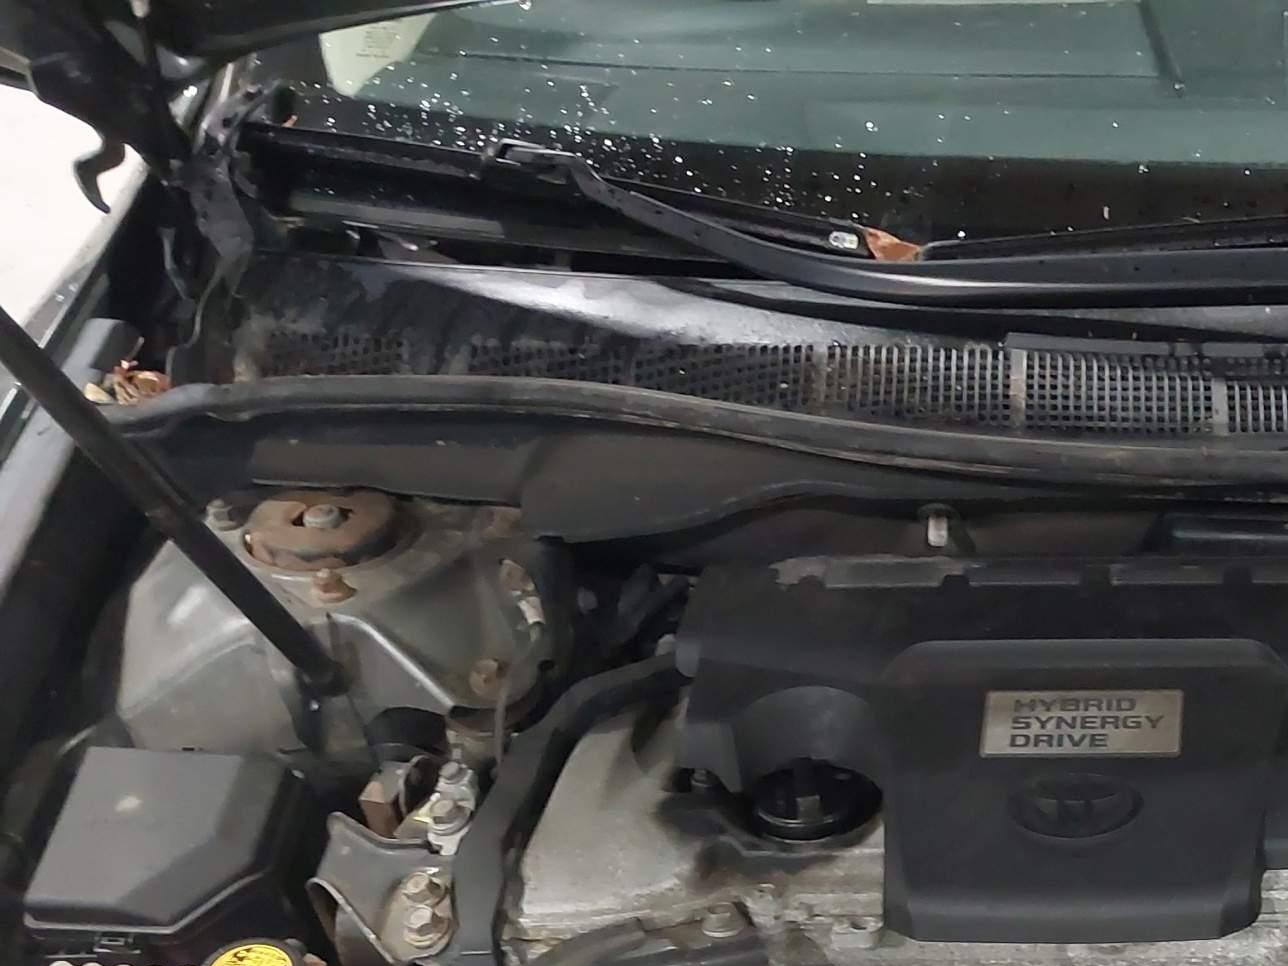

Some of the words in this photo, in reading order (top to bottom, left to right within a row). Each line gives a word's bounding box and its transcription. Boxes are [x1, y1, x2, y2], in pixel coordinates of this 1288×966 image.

[1014, 698, 1137, 712] HYBRID
[1011, 714, 1165, 730] SYNERGY
[1009, 733, 1109, 748] DRIVE
